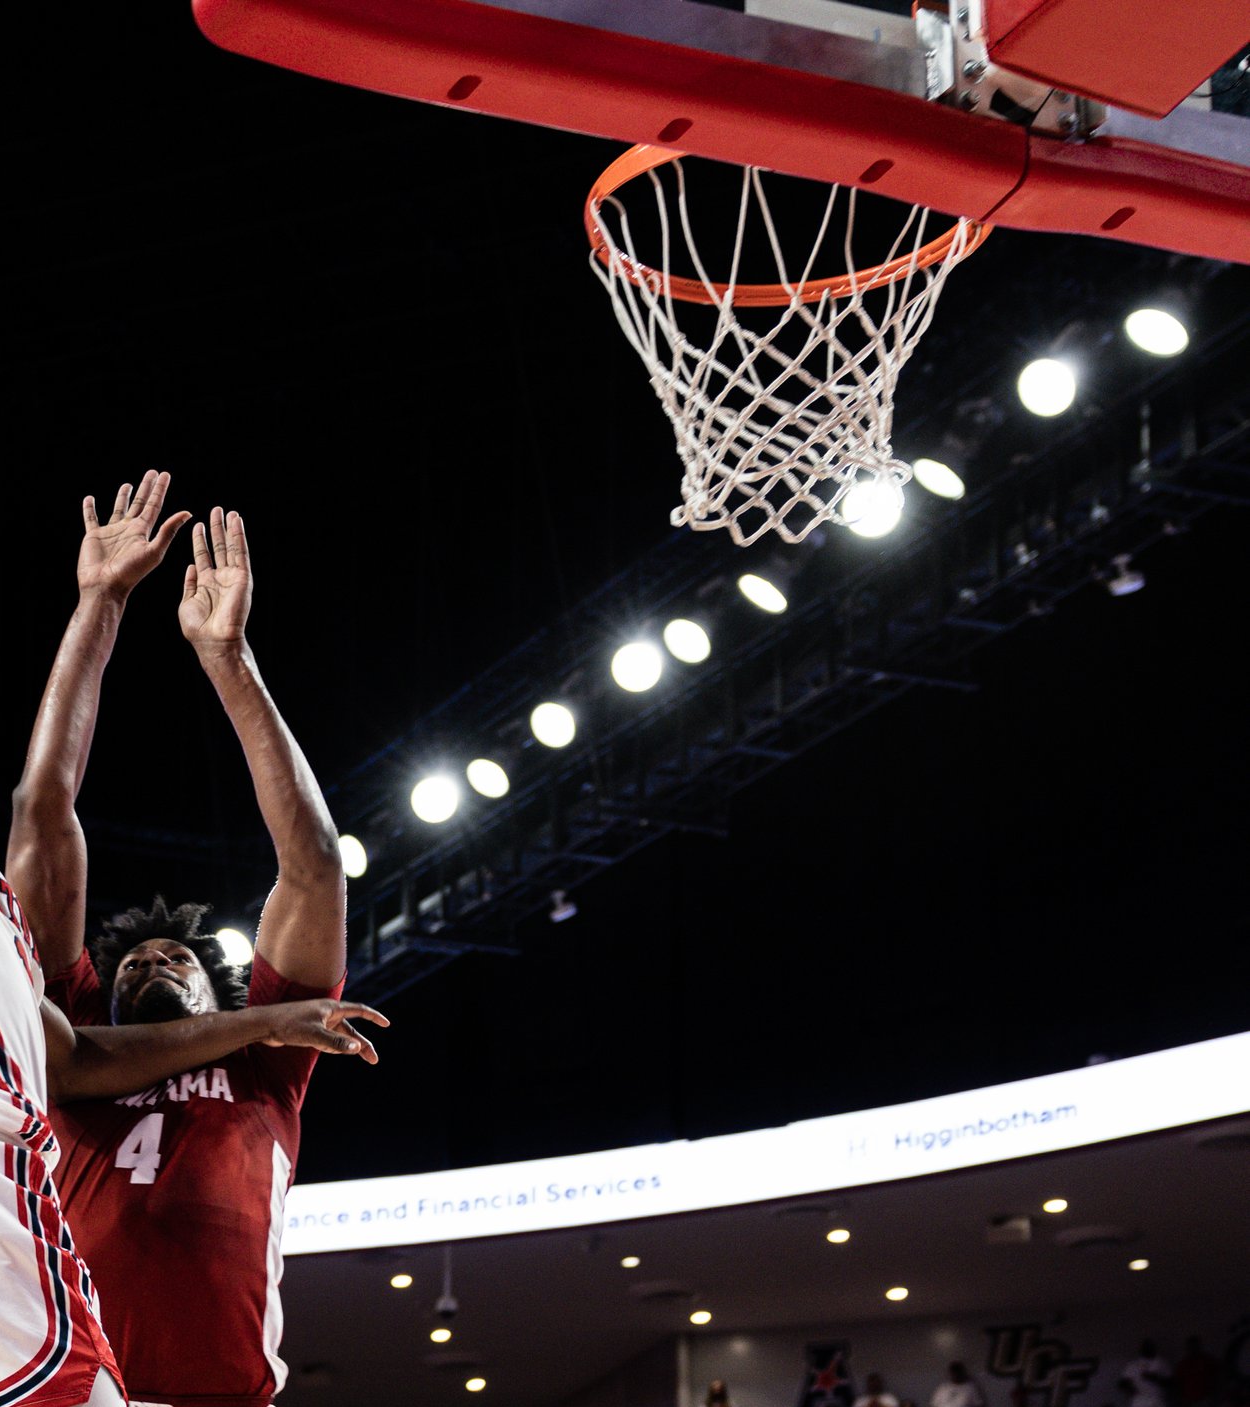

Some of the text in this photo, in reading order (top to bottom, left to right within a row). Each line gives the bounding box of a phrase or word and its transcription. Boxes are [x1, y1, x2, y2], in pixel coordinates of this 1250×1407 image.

[114, 1112, 165, 1185] 4
[893, 1102, 1078, 1151] Higginbotham
[288, 1173, 662, 1231] ance and Financial Services
